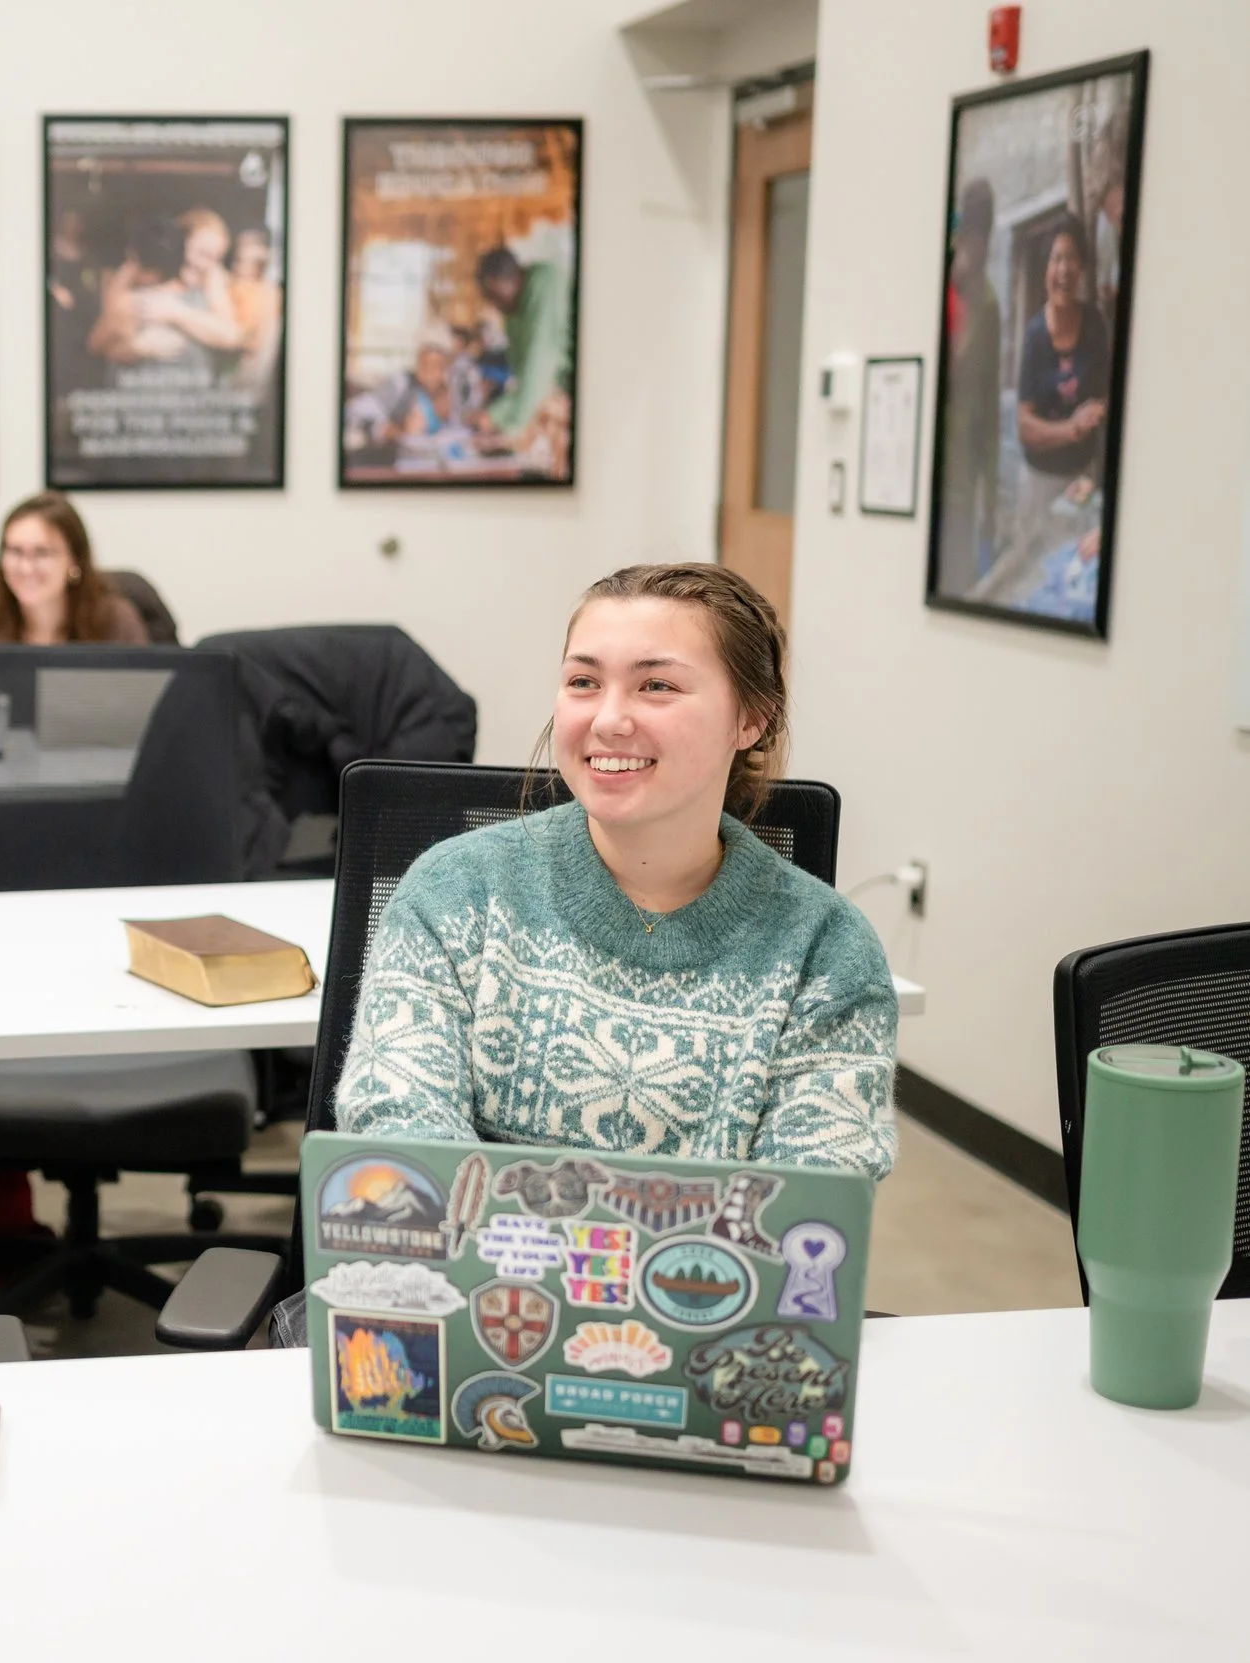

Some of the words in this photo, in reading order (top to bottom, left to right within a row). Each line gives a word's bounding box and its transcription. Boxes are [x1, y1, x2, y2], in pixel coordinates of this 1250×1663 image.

[321, 1221, 444, 1250] YELLOWSTONE
[573, 1226, 632, 1252] YES!
[569, 1252, 631, 1279] YES!
[567, 1278, 630, 1305] YES!
[747, 1327, 806, 1364] Be
[684, 1344, 849, 1390] Present
[555, 1384, 615, 1402] BROAD
[620, 1390, 680, 1408] PORCH
